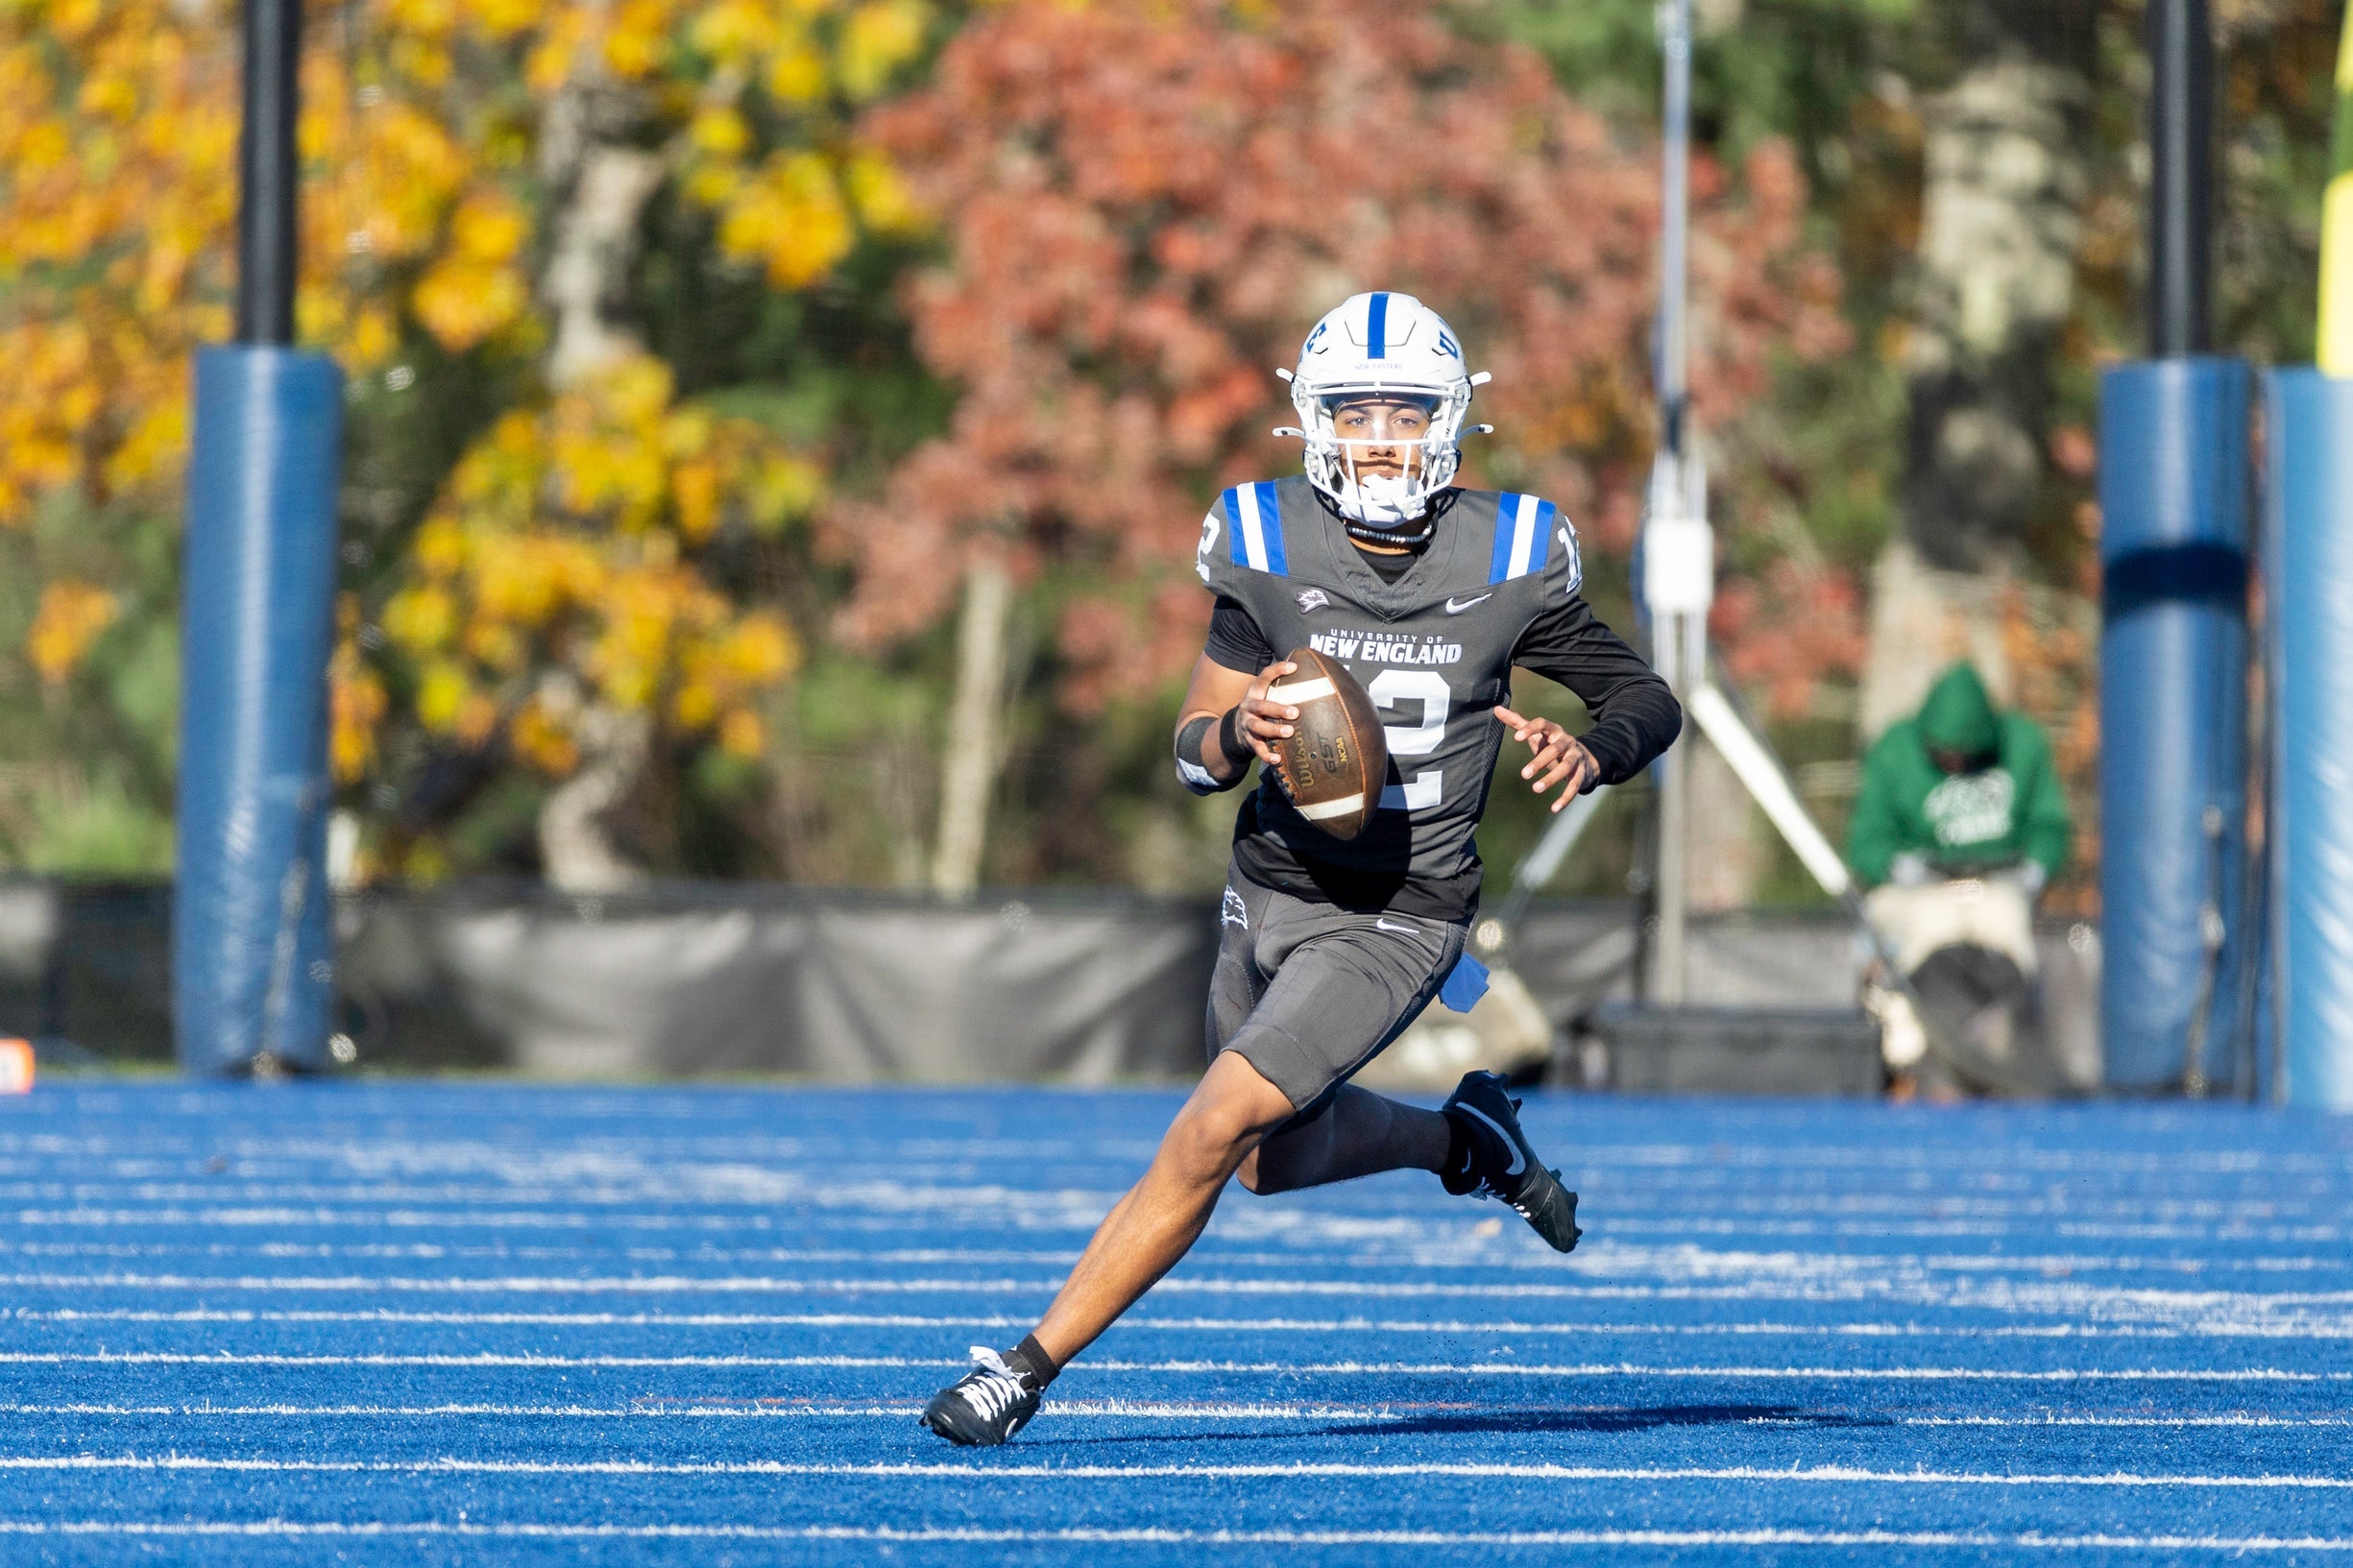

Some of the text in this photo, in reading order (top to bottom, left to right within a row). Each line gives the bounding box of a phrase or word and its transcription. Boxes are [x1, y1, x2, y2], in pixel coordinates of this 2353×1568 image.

[1309, 634, 1463, 665] NEW ENGLAND
[1330, 628, 1443, 644] UNIVERSITY OF
[1335, 736, 1348, 762] NCAA
[1346, 664, 1451, 810] 2
